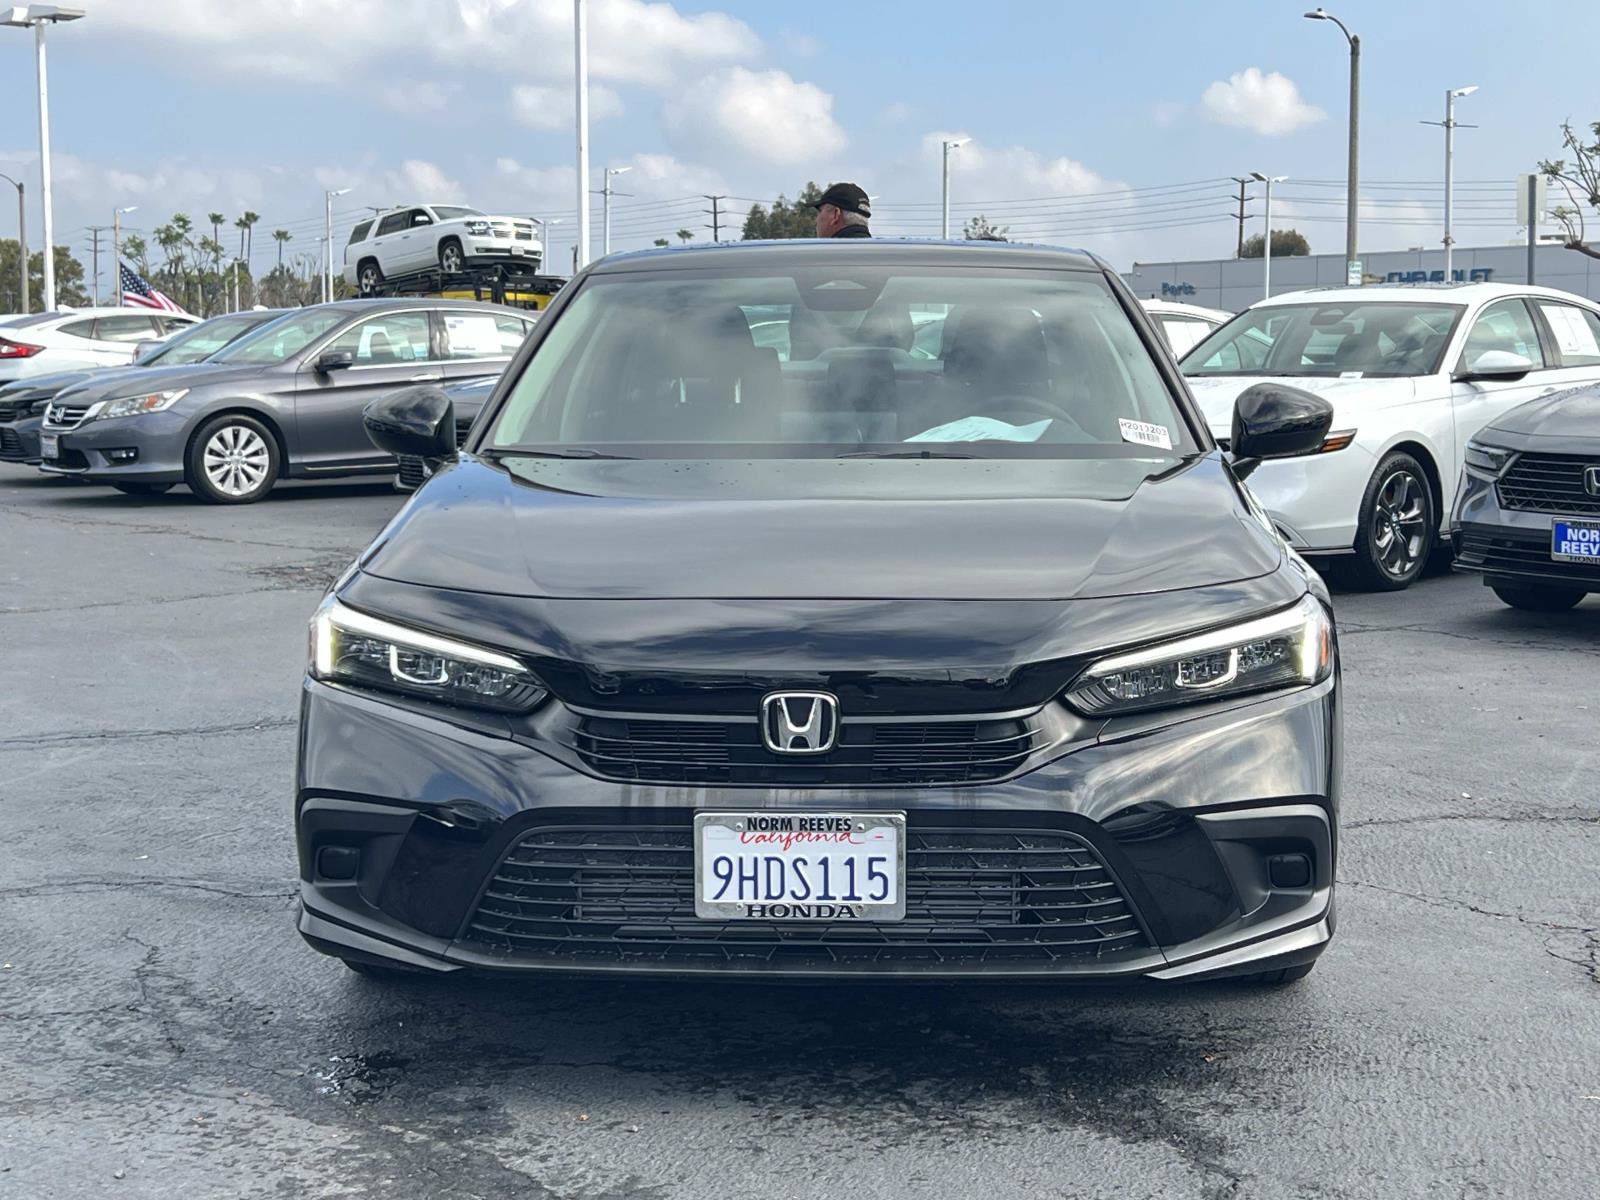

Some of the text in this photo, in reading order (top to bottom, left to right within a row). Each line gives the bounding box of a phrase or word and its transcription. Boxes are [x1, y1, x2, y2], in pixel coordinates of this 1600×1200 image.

[747, 817, 852, 831] NORM REEVES
[741, 832, 865, 851] California
[713, 856, 889, 901] 9HDS115
[745, 904, 858, 918] HONDA
